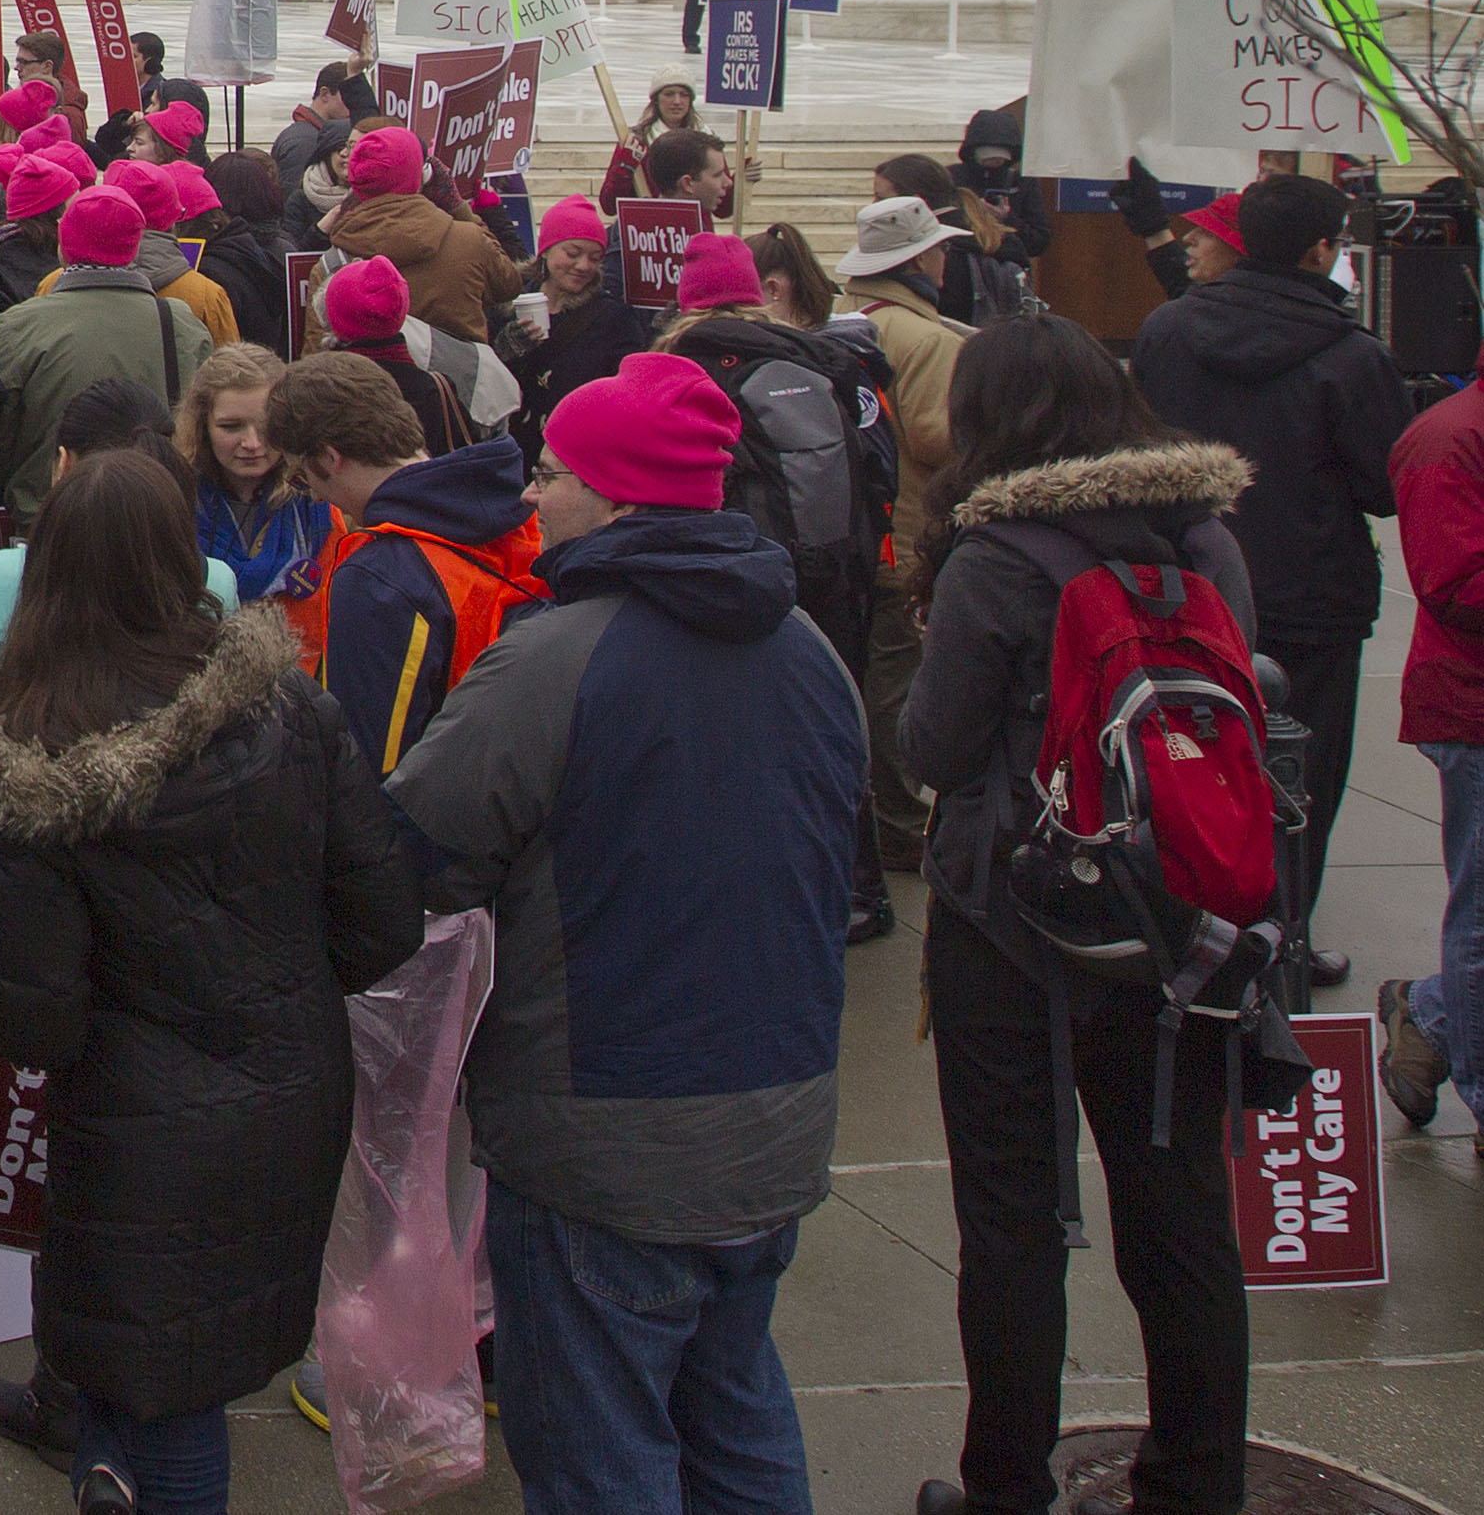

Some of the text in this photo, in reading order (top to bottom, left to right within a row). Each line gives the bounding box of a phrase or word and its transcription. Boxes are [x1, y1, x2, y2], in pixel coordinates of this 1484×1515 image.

[433, 2, 508, 35] SICK
[734, 11, 754, 33] IRS
[724, 48, 760, 62] MAKES ME
[726, 34, 760, 48] CONTROL
[1233, 35, 1323, 68] MAKES
[721, 63, 761, 91] SICK!
[446, 97, 498, 147] Don't
[452, 143, 482, 179] My
[627, 224, 668, 252] Don't
[641, 256, 664, 290] My
[1306, 1067, 1358, 1234] My Care
[1262, 1147, 1307, 1263] Don't
